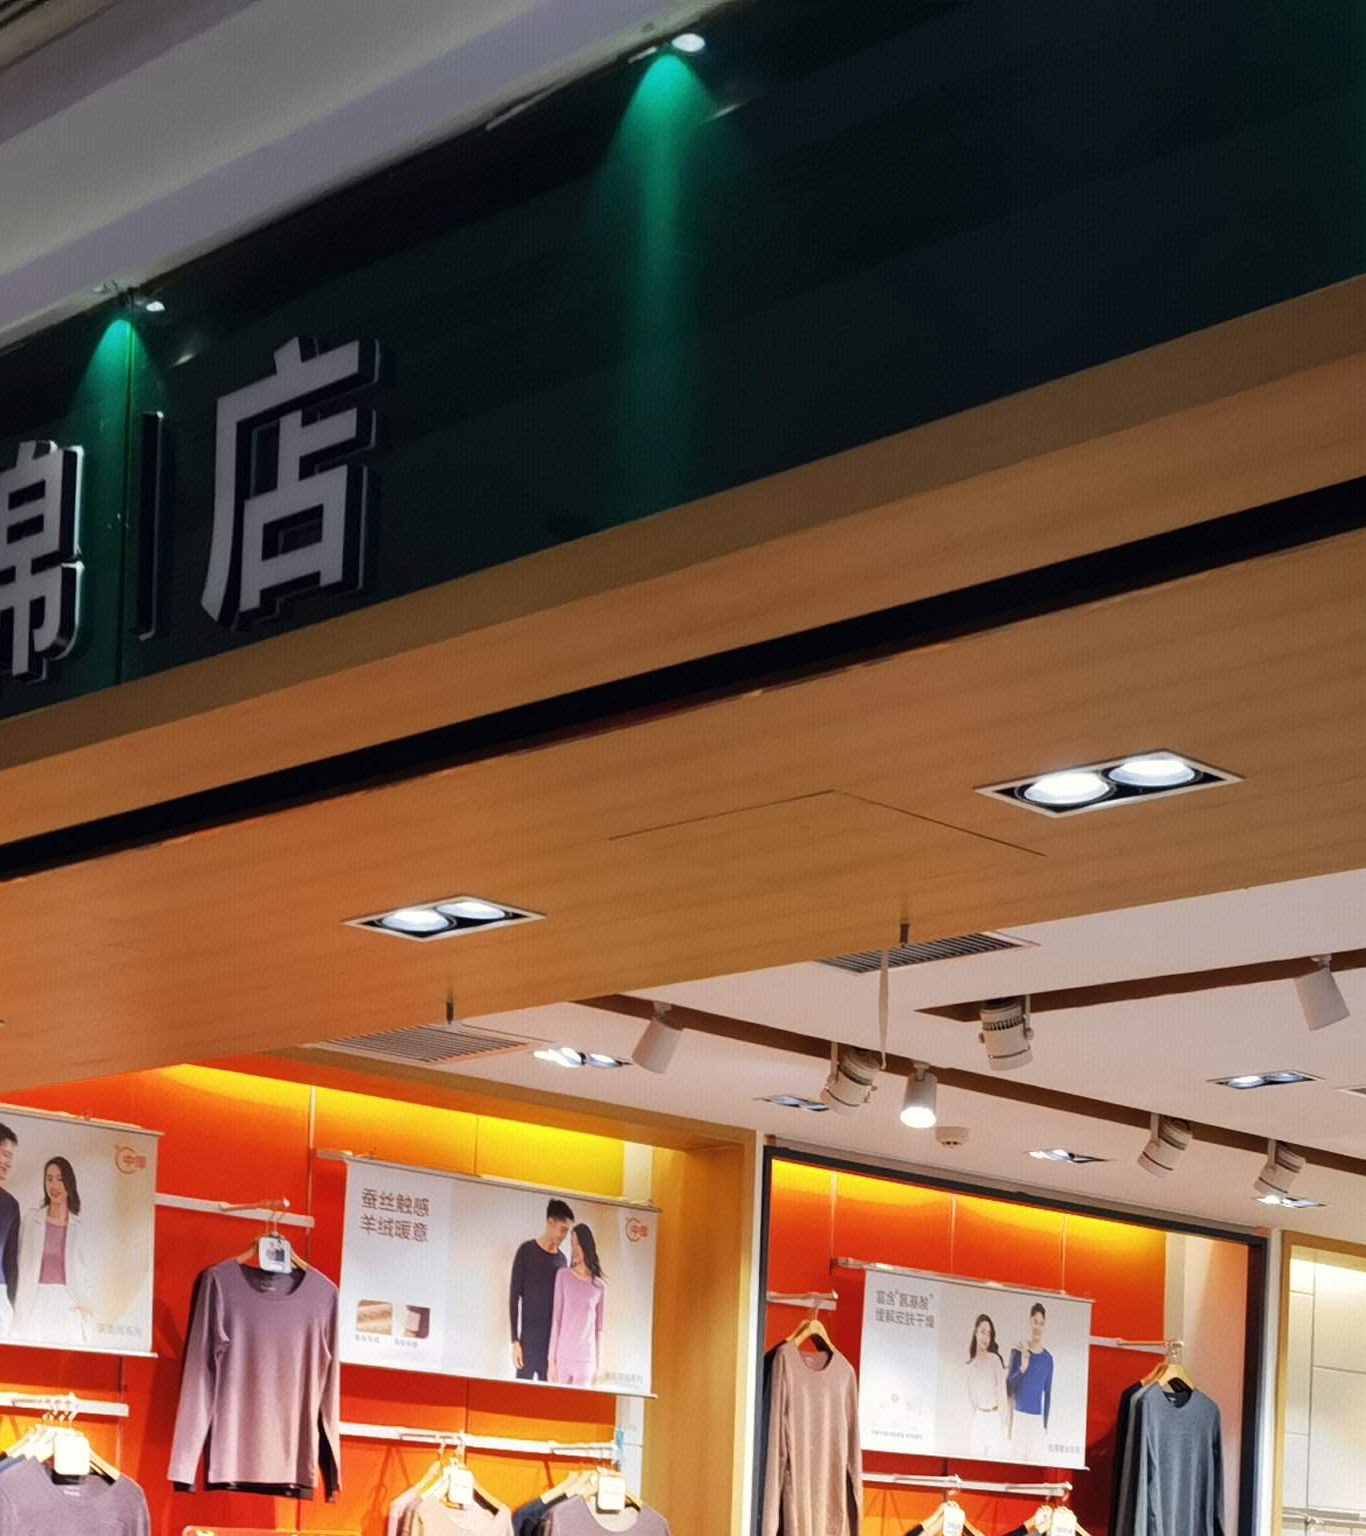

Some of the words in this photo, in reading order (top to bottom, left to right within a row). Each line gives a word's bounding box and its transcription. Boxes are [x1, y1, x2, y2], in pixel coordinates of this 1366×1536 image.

[361, 1188, 430, 1217] 蚕丝触感
[358, 1213, 429, 1243] 羊绒暖意
